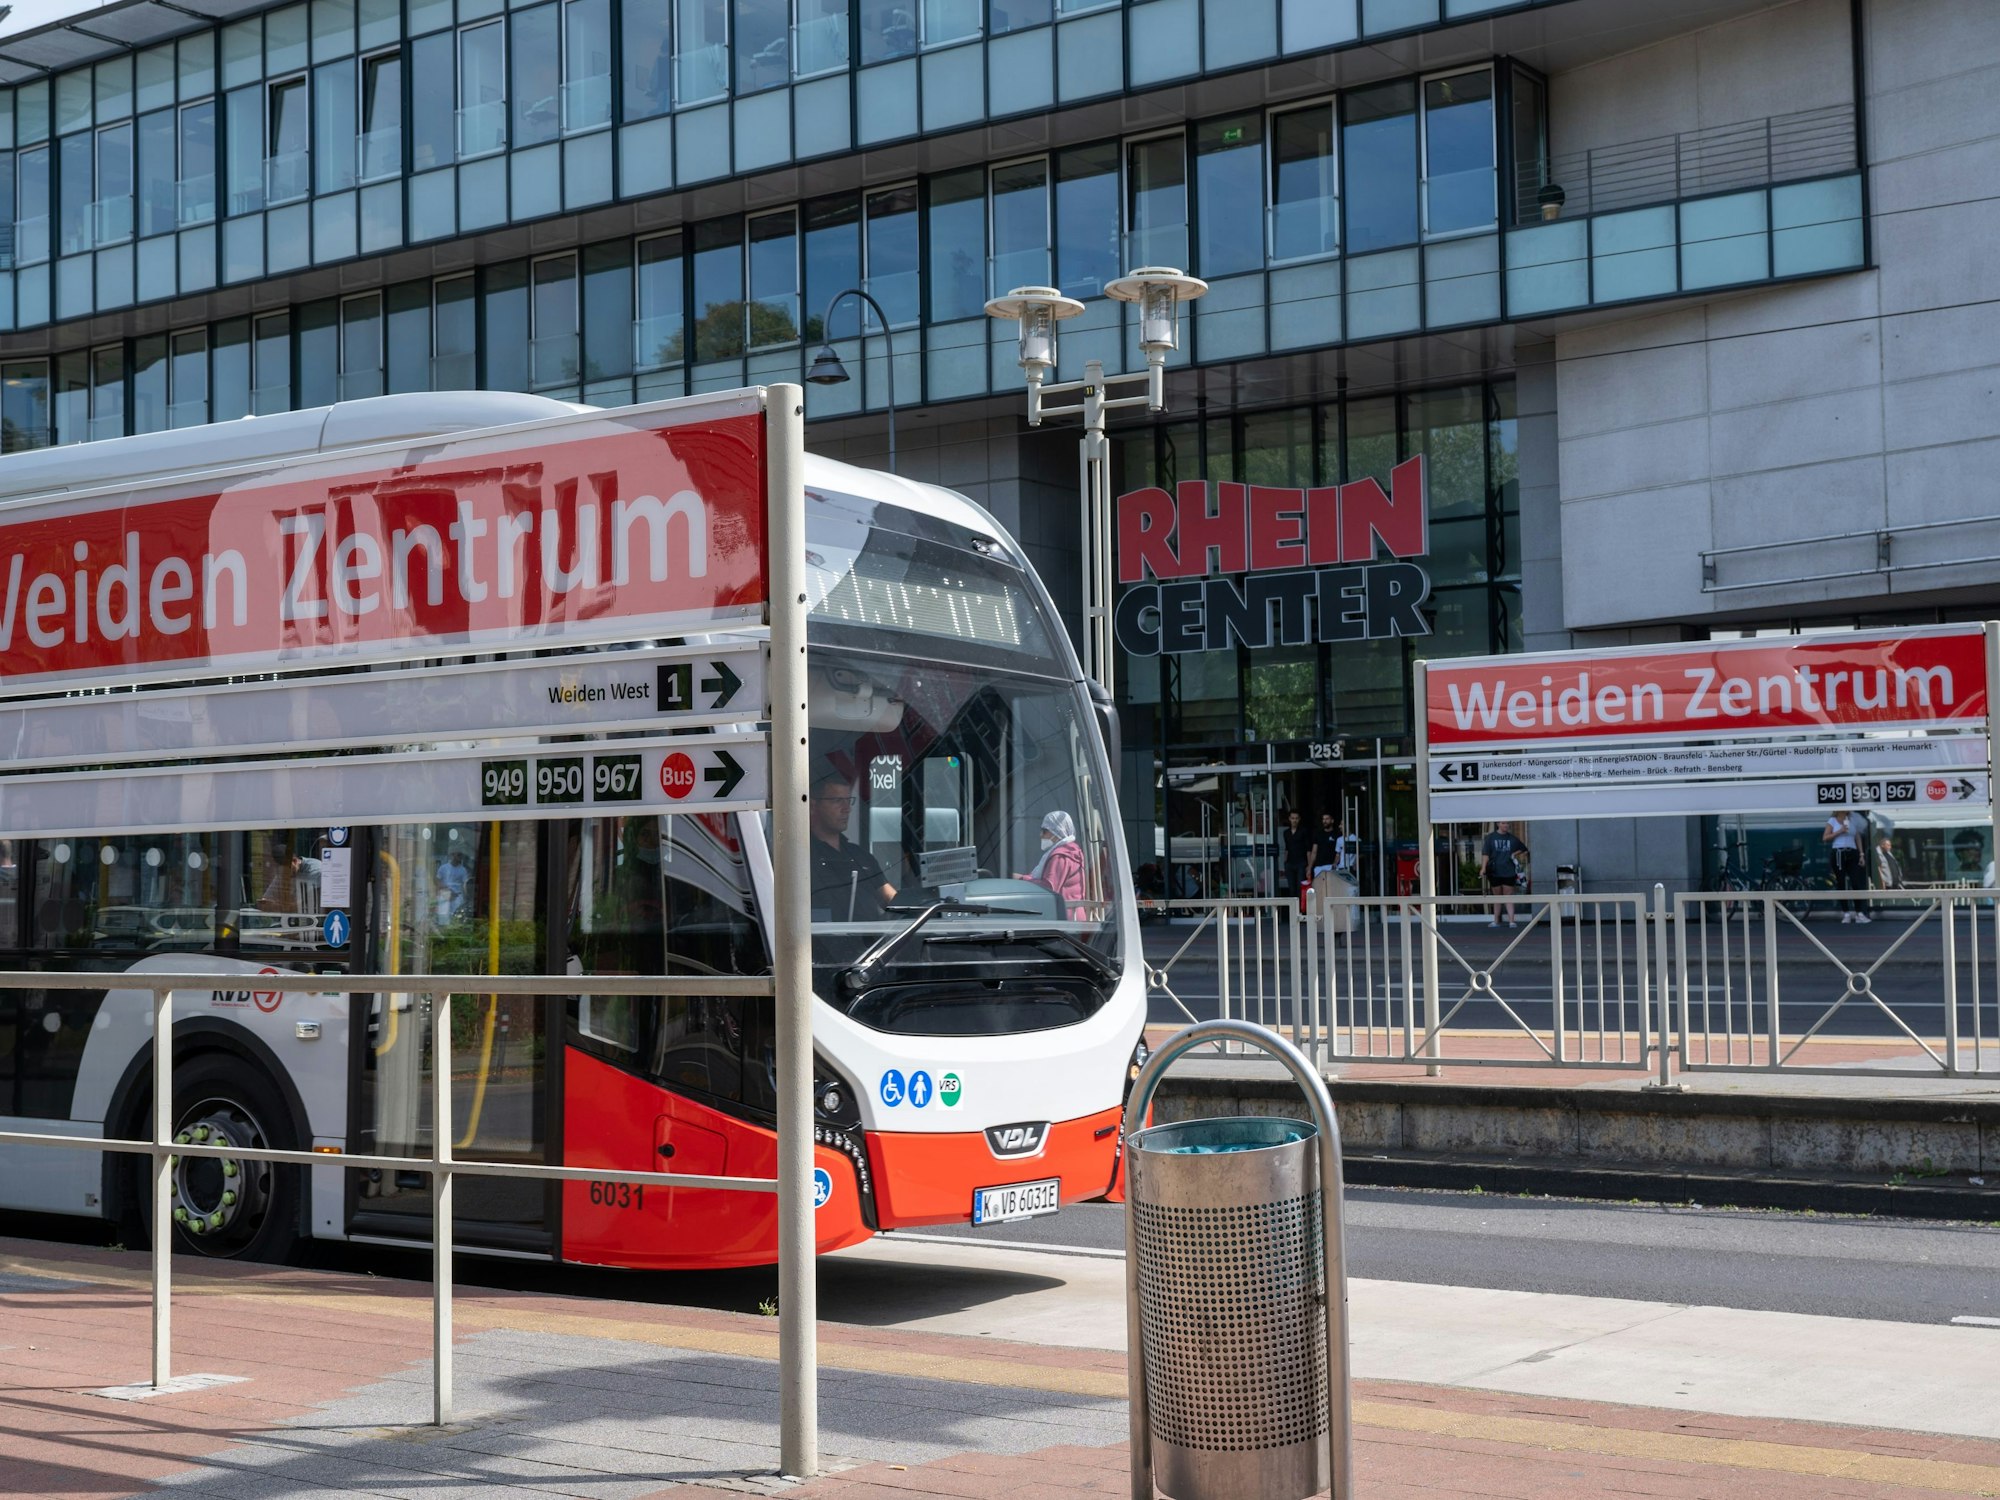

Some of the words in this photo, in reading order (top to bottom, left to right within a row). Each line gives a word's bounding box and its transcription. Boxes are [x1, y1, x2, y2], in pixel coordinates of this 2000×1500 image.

[1116, 453, 1429, 583] RHEIN
[279, 490, 708, 621] Zentrum
[1115, 562, 1432, 657] CENTER
[548, 684, 606, 704] Weiden
[610, 682, 650, 700] West
[667, 672, 682, 703] 1
[1447, 672, 1664, 731] Weiden
[1683, 664, 1954, 719] Zentrum
[1308, 743, 1341, 759] 1253
[1482, 759, 1522, 769] Junkersdorf
[1663, 752, 1702, 761] Braunsfeld
[1709, 750, 1744, 759] Aachener
[1746, 747, 1787, 758] Str./Gürtel
[1793, 746, 1838, 756] Rudolfplatz
[1845, 744, 1885, 753] Neumarkt
[1892, 742, 1932, 752] Heumarkt
[484, 768, 524, 798] 949
[538, 766, 583, 797] 950
[595, 763, 641, 794] 967
[662, 767, 694, 787] Bus
[1465, 765, 1475, 779] 1
[1491, 772, 1536, 782] Deutz/Messe
[1542, 770, 1557, 779] Kalk
[1607, 767, 1641, 777] Merheim
[1647, 766, 1667, 775] Brück
[1674, 765, 1701, 774] Refrath
[1707, 764, 1743, 774] Bensberg
[1819, 786, 1845, 801] 949
[1852, 785, 1880, 800] 950
[1887, 784, 1915, 799] 967
[1927, 785, 1946, 795] Bus
[938, 1080, 957, 1091] VRS
[993, 1127, 1039, 1150] VDL
[590, 1180, 643, 1211] 6031
[983, 1194, 992, 1218] K
[1001, 1190, 1016, 1215] VB
[1019, 1184, 1055, 1212] 6031E
